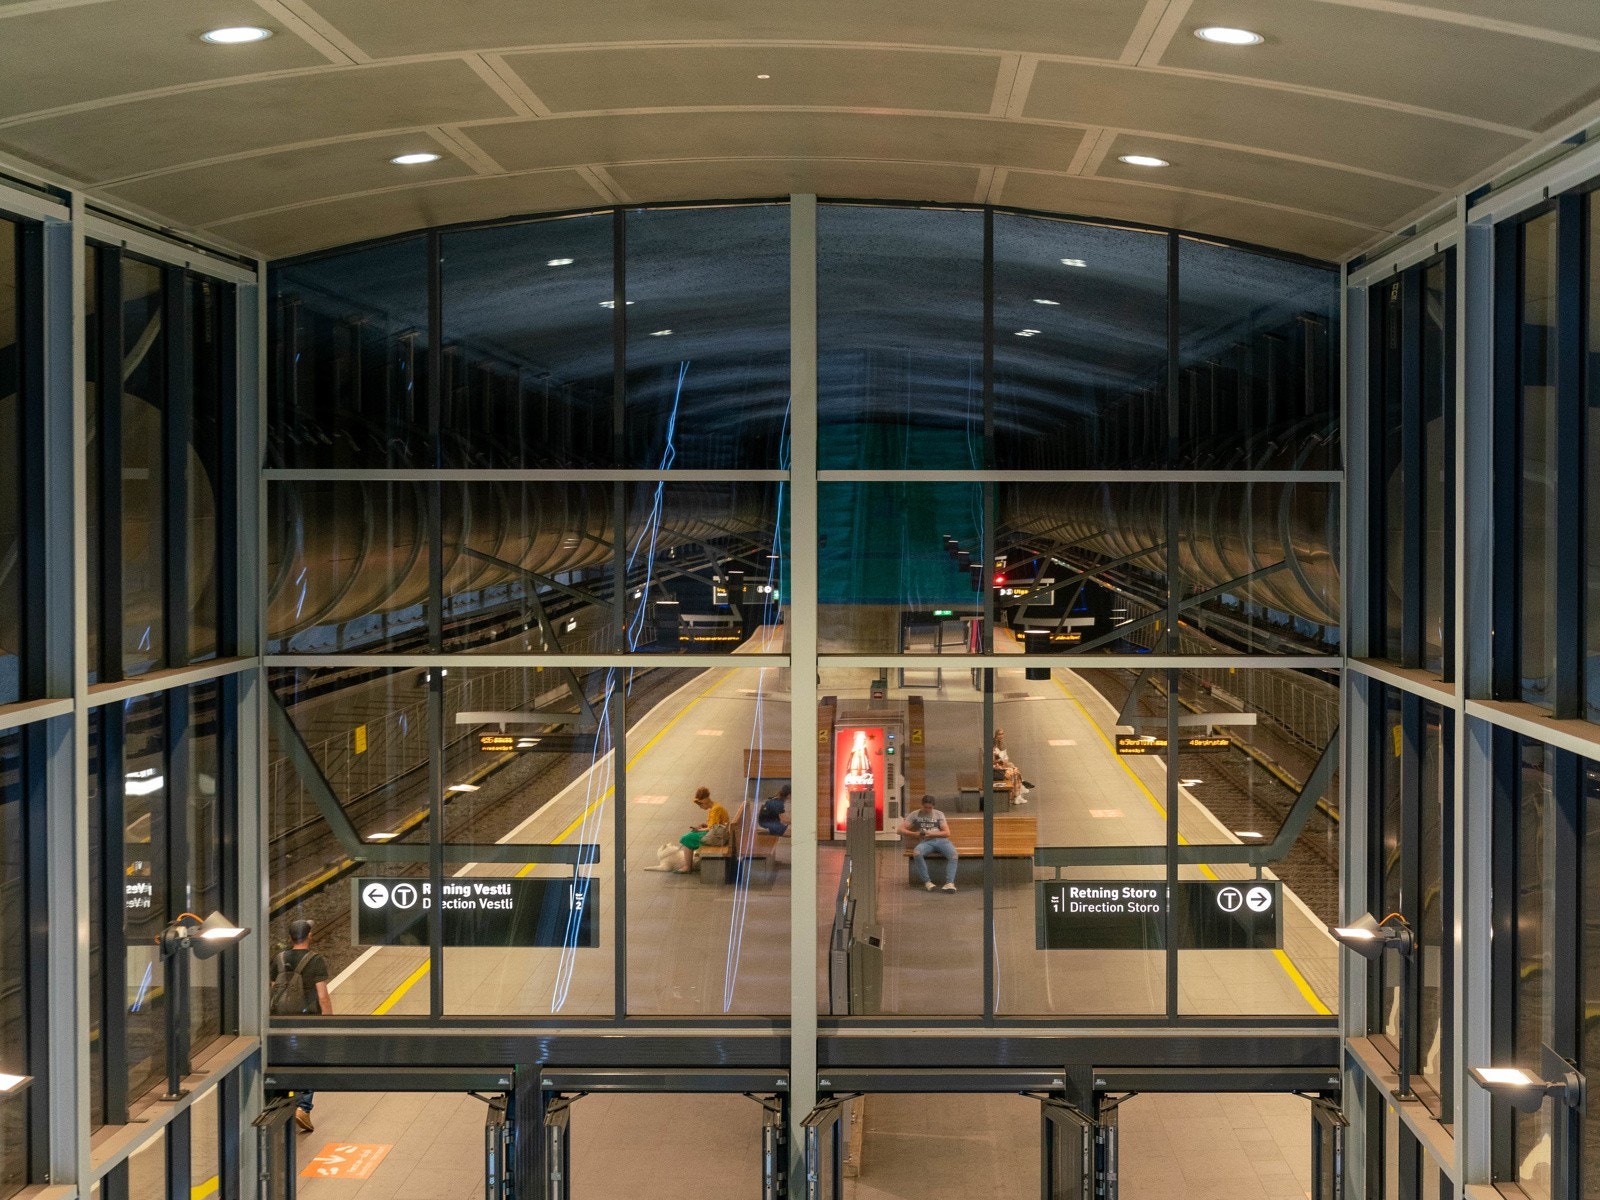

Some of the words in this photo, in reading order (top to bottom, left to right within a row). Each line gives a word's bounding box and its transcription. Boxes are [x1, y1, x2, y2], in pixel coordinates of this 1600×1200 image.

[422, 883, 471, 898] Rning
[474, 883, 511, 896] Vestli
[1070, 887, 1119, 900] Retning
[1122, 887, 1157, 898] Storo
[422, 898, 476, 909] Dection
[479, 898, 513, 909] Vestli
[575, 901, 582, 910] 2
[1053, 904, 1058, 912] 1
[1070, 902, 1124, 912] Direction
[1127, 902, 1160, 912] Storo
